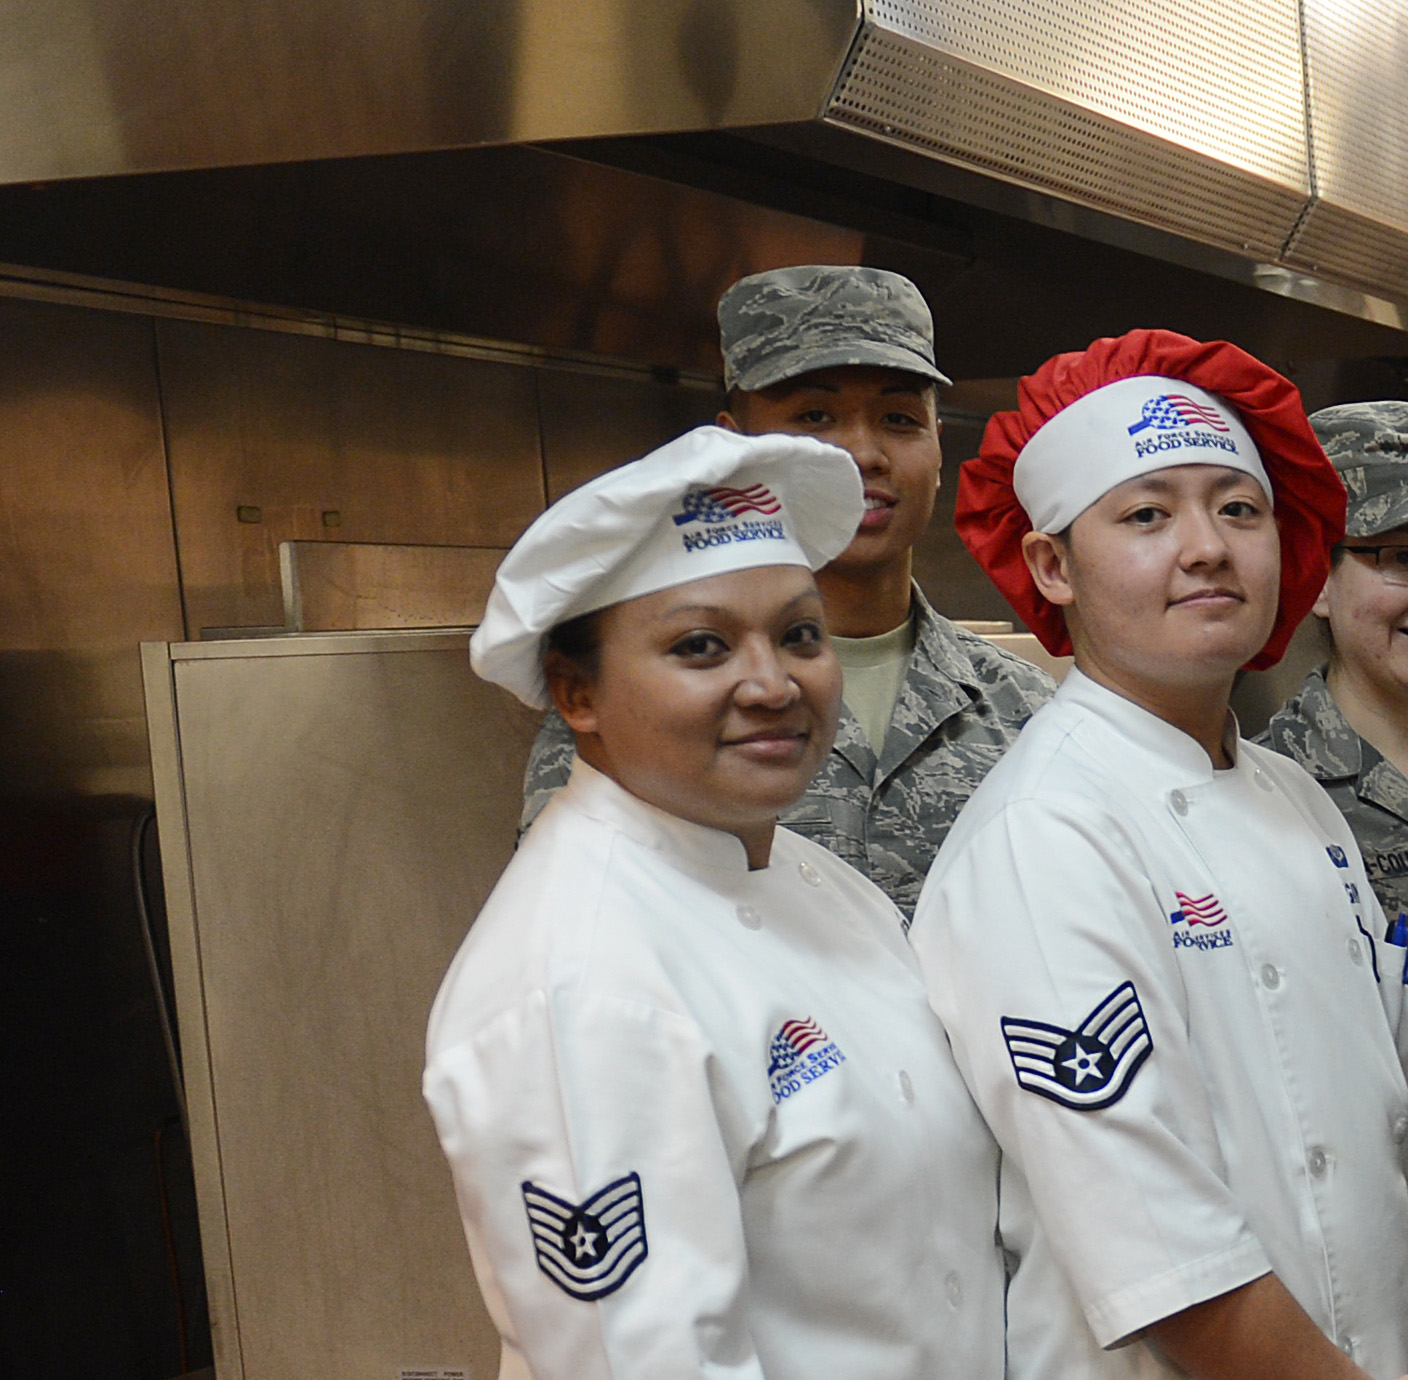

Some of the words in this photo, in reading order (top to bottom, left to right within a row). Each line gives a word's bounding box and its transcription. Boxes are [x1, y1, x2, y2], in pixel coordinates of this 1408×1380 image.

[1136, 439, 1182, 458] FOOD
[1183, 437, 1239, 455] SERVICE
[684, 532, 731, 552] FOOD
[732, 527, 785, 542] SERVICE
